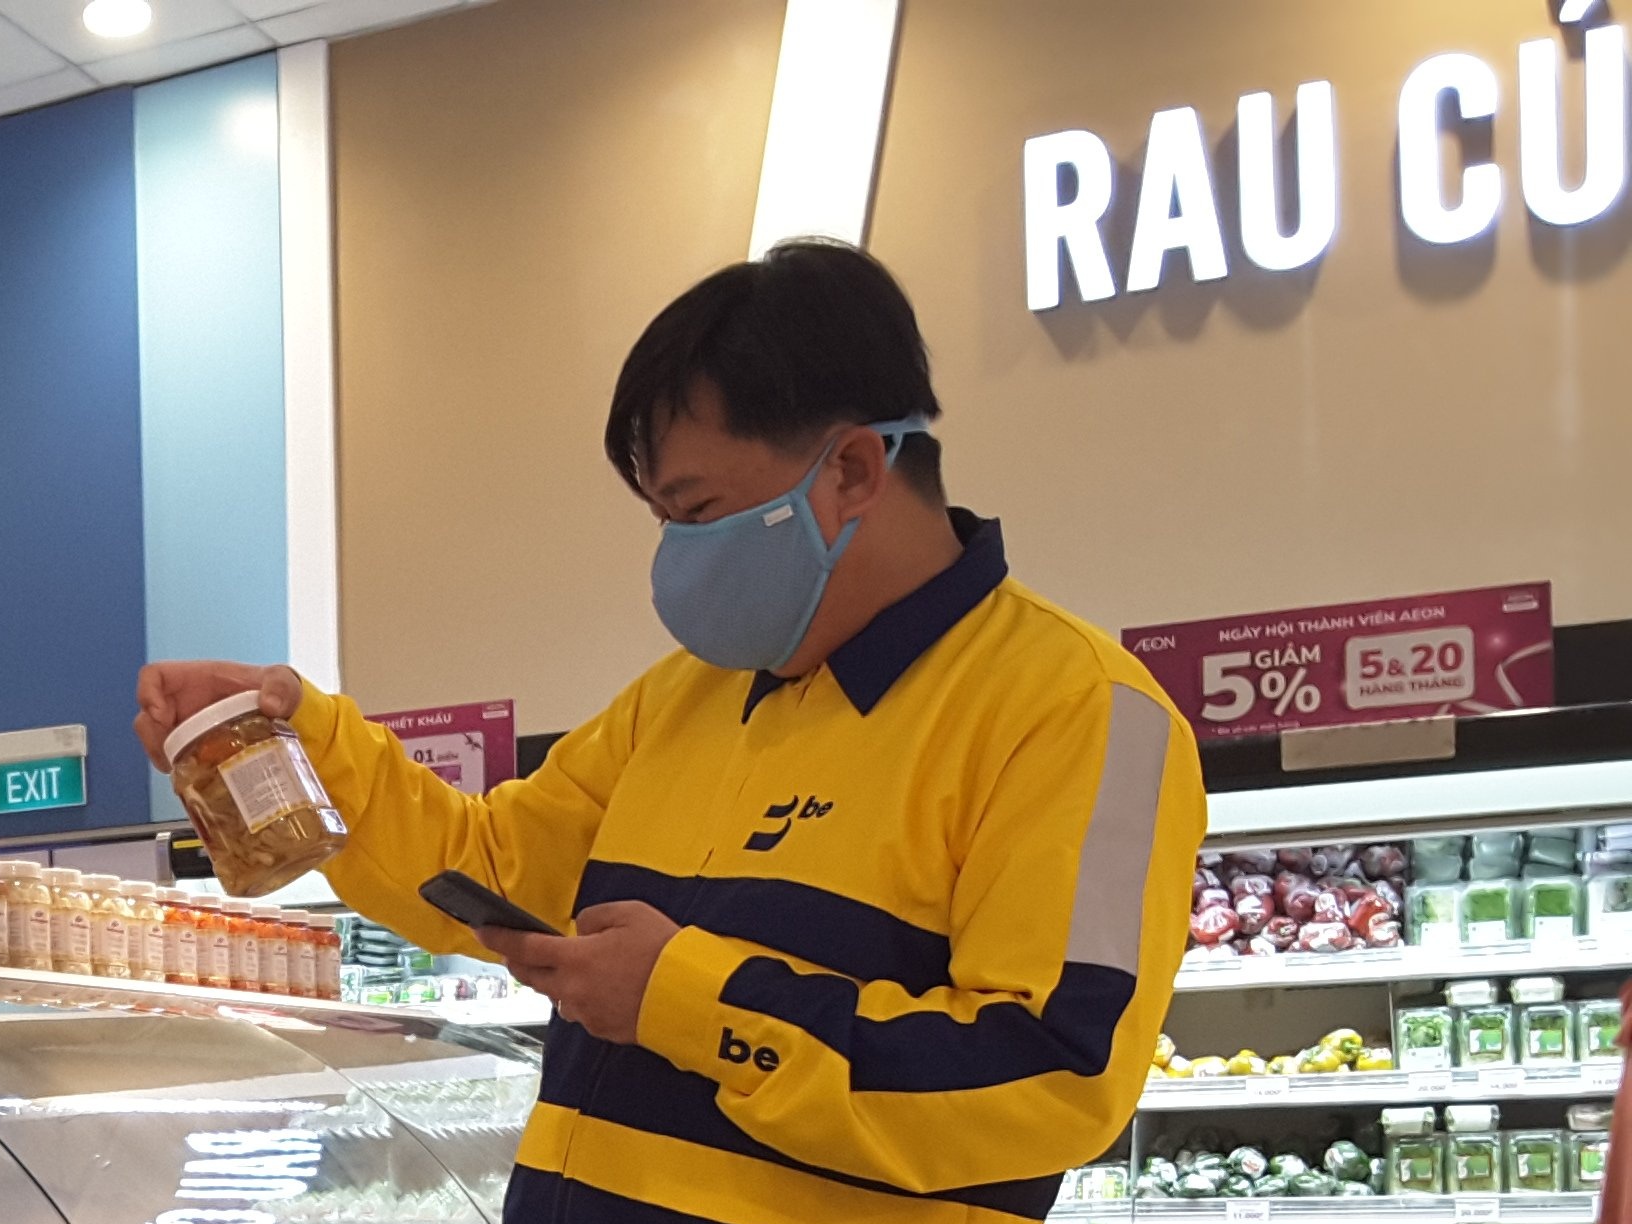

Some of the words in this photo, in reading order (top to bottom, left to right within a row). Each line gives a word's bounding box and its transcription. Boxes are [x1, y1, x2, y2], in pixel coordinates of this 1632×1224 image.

[1023, 80, 1336, 311] RAU
[1219, 624, 1262, 642] NGÀY
[1265, 620, 1294, 637] HỘI
[1298, 616, 1355, 633] THÀNH
[1399, 605, 1446, 622] AEON
[1255, 641, 1321, 669] GIẢM
[6, 767, 61, 804] EXIT
[797, 795, 833, 819] be
[718, 1026, 780, 1072] be
